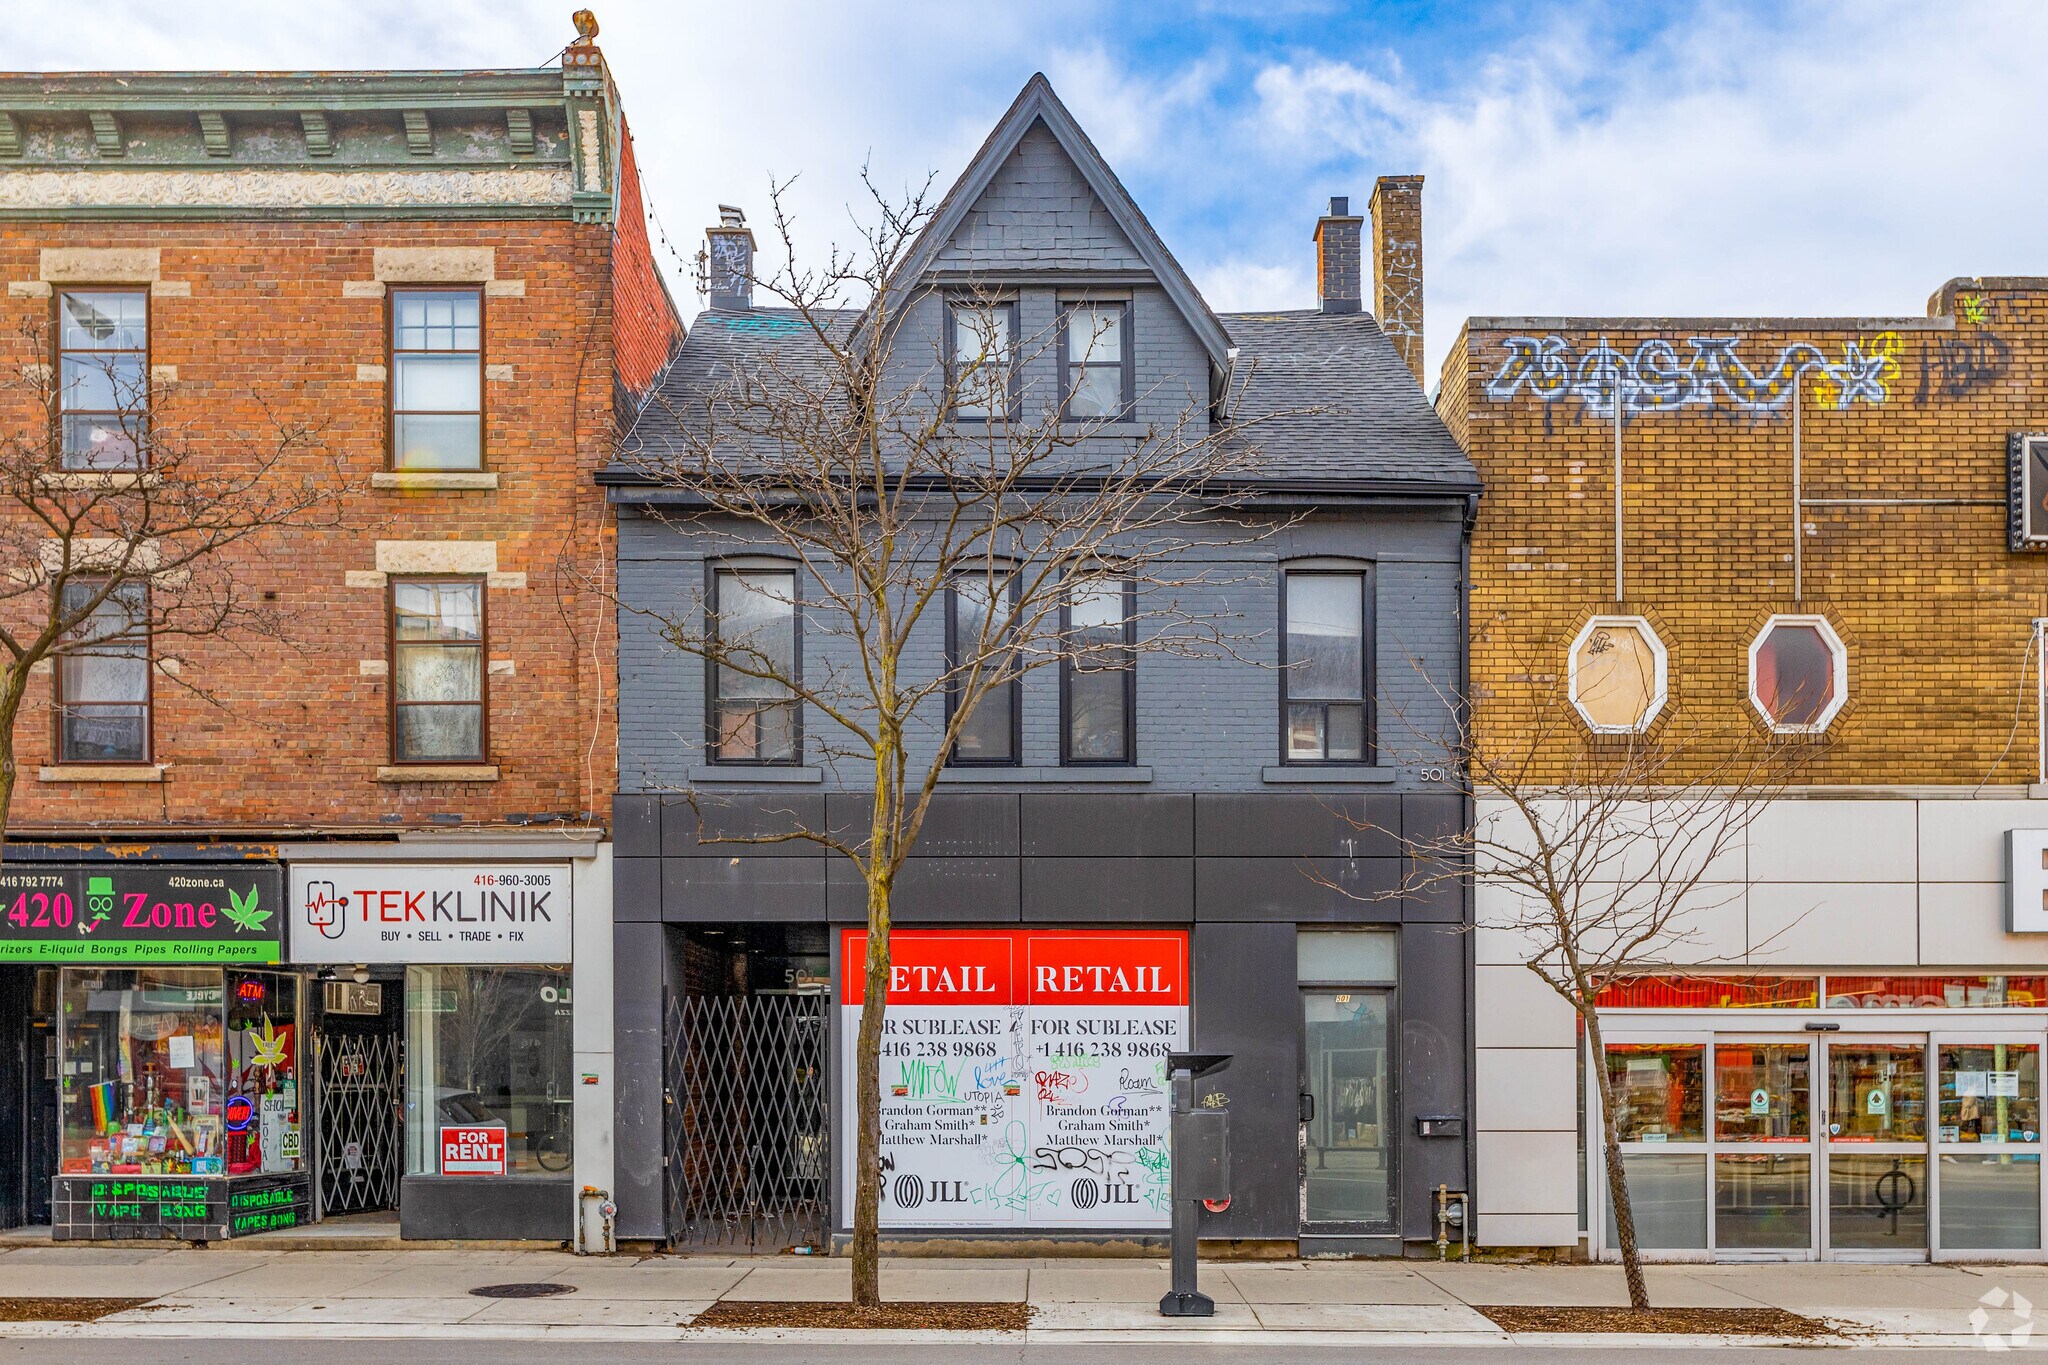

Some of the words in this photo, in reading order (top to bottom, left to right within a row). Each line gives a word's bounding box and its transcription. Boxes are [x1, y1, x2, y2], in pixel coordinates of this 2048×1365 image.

[1420, 768, 1445, 781] 501
[0, 876, 18, 887] 416
[20, 876, 38, 887] 792
[40, 876, 64, 887] 7774
[168, 876, 225, 888] 420zone.ca
[473, 874, 551, 886] 416-960-3005
[8, 891, 73, 928] 420
[122, 893, 217, 928] Zone
[381, 931, 401, 942] BUY
[418, 931, 442, 942] SELL
[459, 931, 491, 942] TRADE
[509, 931, 525, 942] FIX
[39, 944, 85, 956] E-liquid
[91, 944, 128, 956] Bongs
[134, 944, 166, 956] Pipes
[173, 944, 214, 956] Rolling
[217, 944, 258, 956] Papers
[863, 966, 996, 993] ETAIL
[1034, 966, 1171, 993] RETAIL
[239, 983, 263, 998] ATM
[902, 1019, 1001, 1035] SUBLEASE
[1031, 1019, 1070, 1035] FOR
[1076, 1019, 1177, 1035] SUBLEASE
[882, 1041, 911, 1057] 416
[916, 1041, 947, 1057] 238
[953, 1041, 997, 1057] 9868
[1036, 1041, 1050, 1057] +1
[1055, 1041, 1084, 1057] 416
[1090, 1041, 1121, 1057] 238
[1127, 1041, 1172, 1057] 9868
[963, 1091, 1005, 1103] UTOPIA
[263, 1099, 284, 1112] SHO
[1046, 1105, 1097, 1116] Brandon
[885, 1119, 932, 1131] Graham
[1058, 1119, 1106, 1131] Graham
[282, 1133, 299, 1148] CBD
[458, 1131, 489, 1144] FOR
[1046, 1134, 1100, 1146] Matthew
[445, 1144, 502, 1160] RENT
[231, 1189, 294, 1207] DISPOSABLE
[96, 1203, 142, 1218] VAPE
[161, 1203, 207, 1218] BONG
[234, 1213, 268, 1230] VAPES
[270, 1211, 296, 1227] BONG
